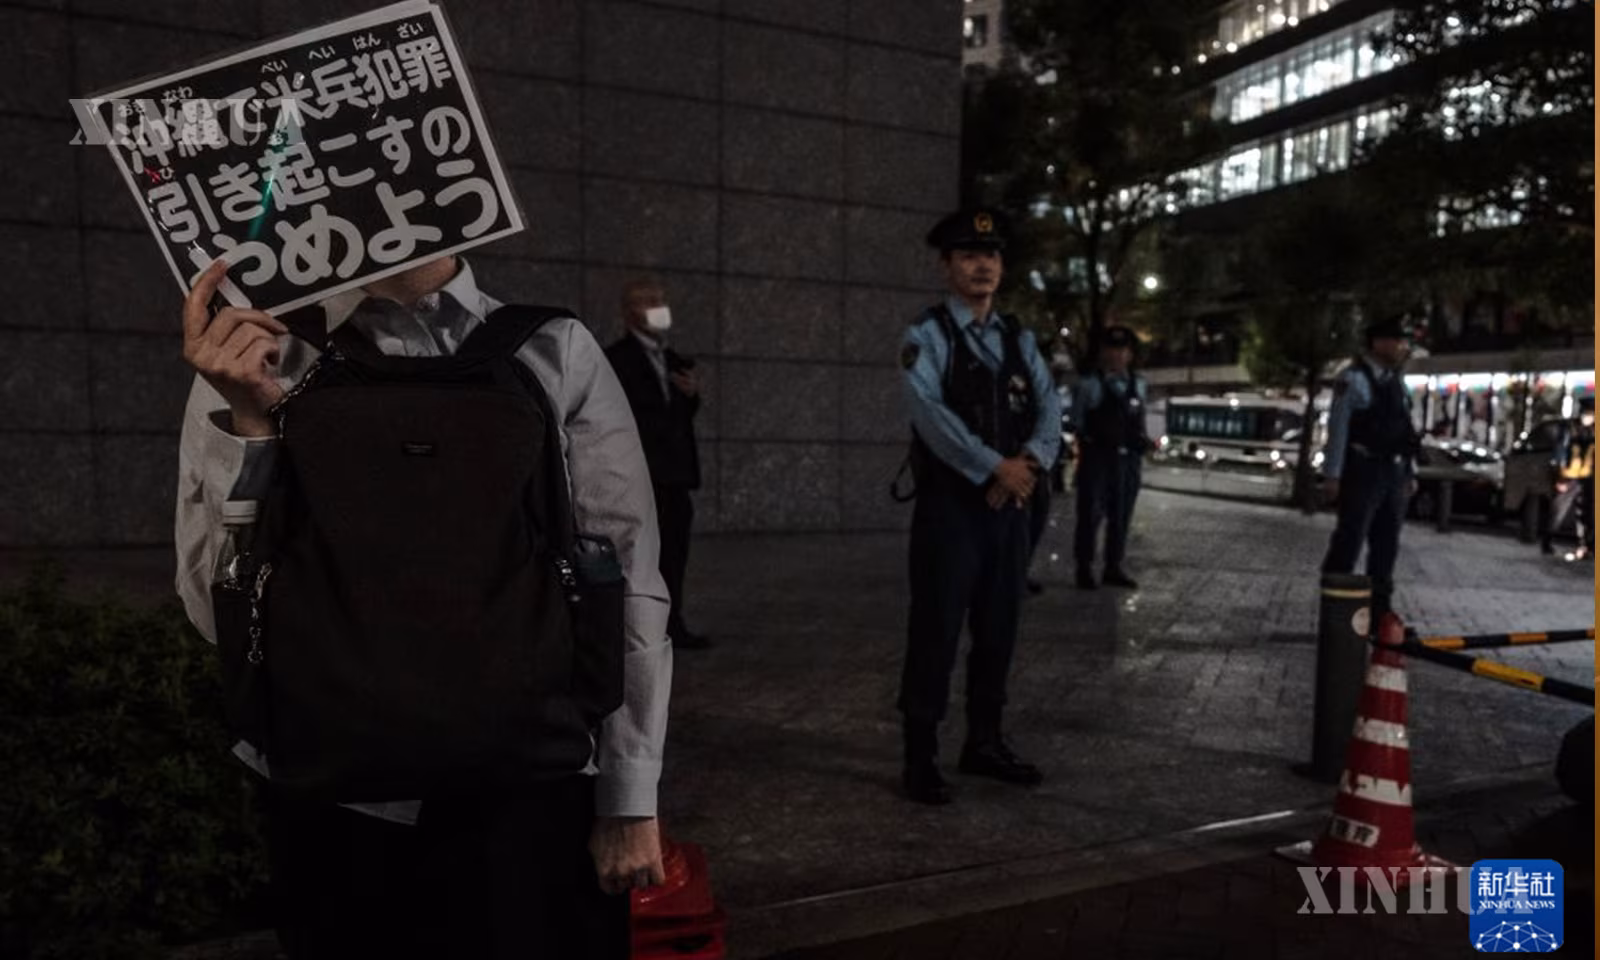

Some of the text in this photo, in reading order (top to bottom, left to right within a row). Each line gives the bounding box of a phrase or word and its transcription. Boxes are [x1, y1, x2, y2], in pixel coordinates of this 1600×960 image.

[114, 35, 452, 174] 沖縄で米兵犯罪
[308, 45, 336, 60] へい
[352, 32, 381, 50] はん
[396, 22, 424, 39] ざい
[147, 105, 472, 243] 引き起こすの
[189, 158, 499, 309] やめよう
